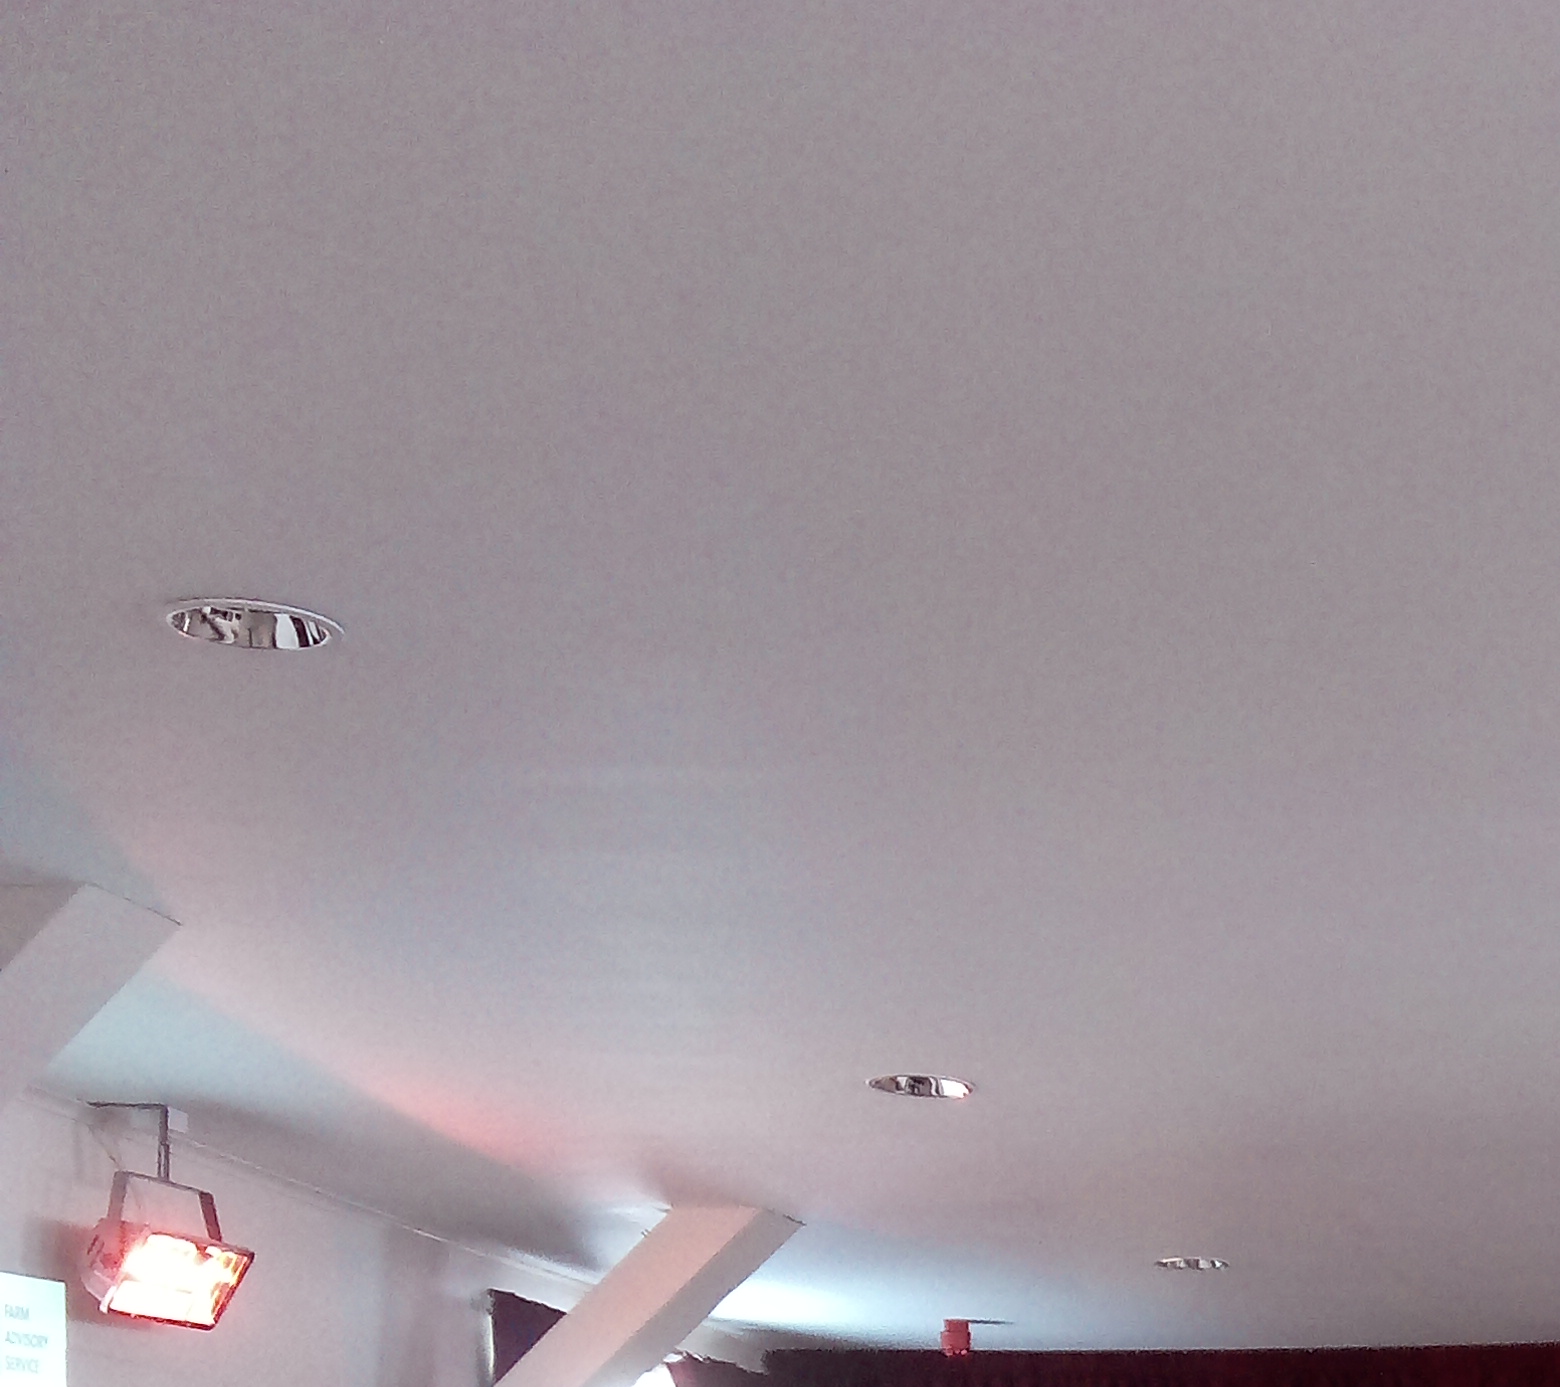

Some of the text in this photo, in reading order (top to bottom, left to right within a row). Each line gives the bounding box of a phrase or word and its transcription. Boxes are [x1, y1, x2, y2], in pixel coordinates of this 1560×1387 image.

[4, 1303, 30, 1321] FARM
[4, 1330, 49, 1349] ADVISORY
[4, 1354, 40, 1374] SERVICE
